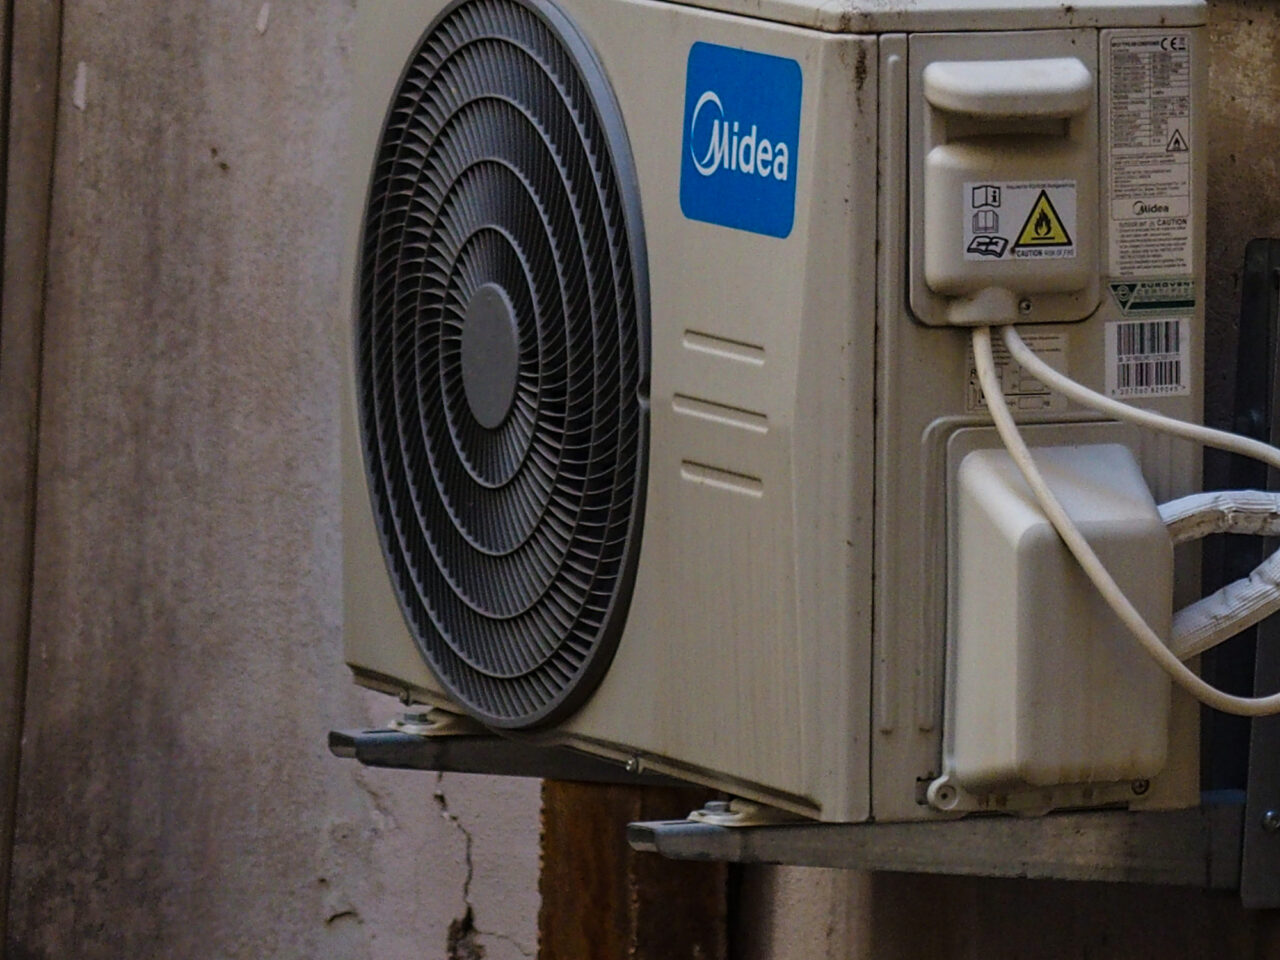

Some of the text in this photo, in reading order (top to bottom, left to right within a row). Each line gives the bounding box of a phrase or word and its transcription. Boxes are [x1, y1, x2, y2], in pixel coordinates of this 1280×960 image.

[690, 91, 789, 181] Midea
[1133, 200, 1170, 216] Midea
[1016, 249, 1042, 257] CAUTION
